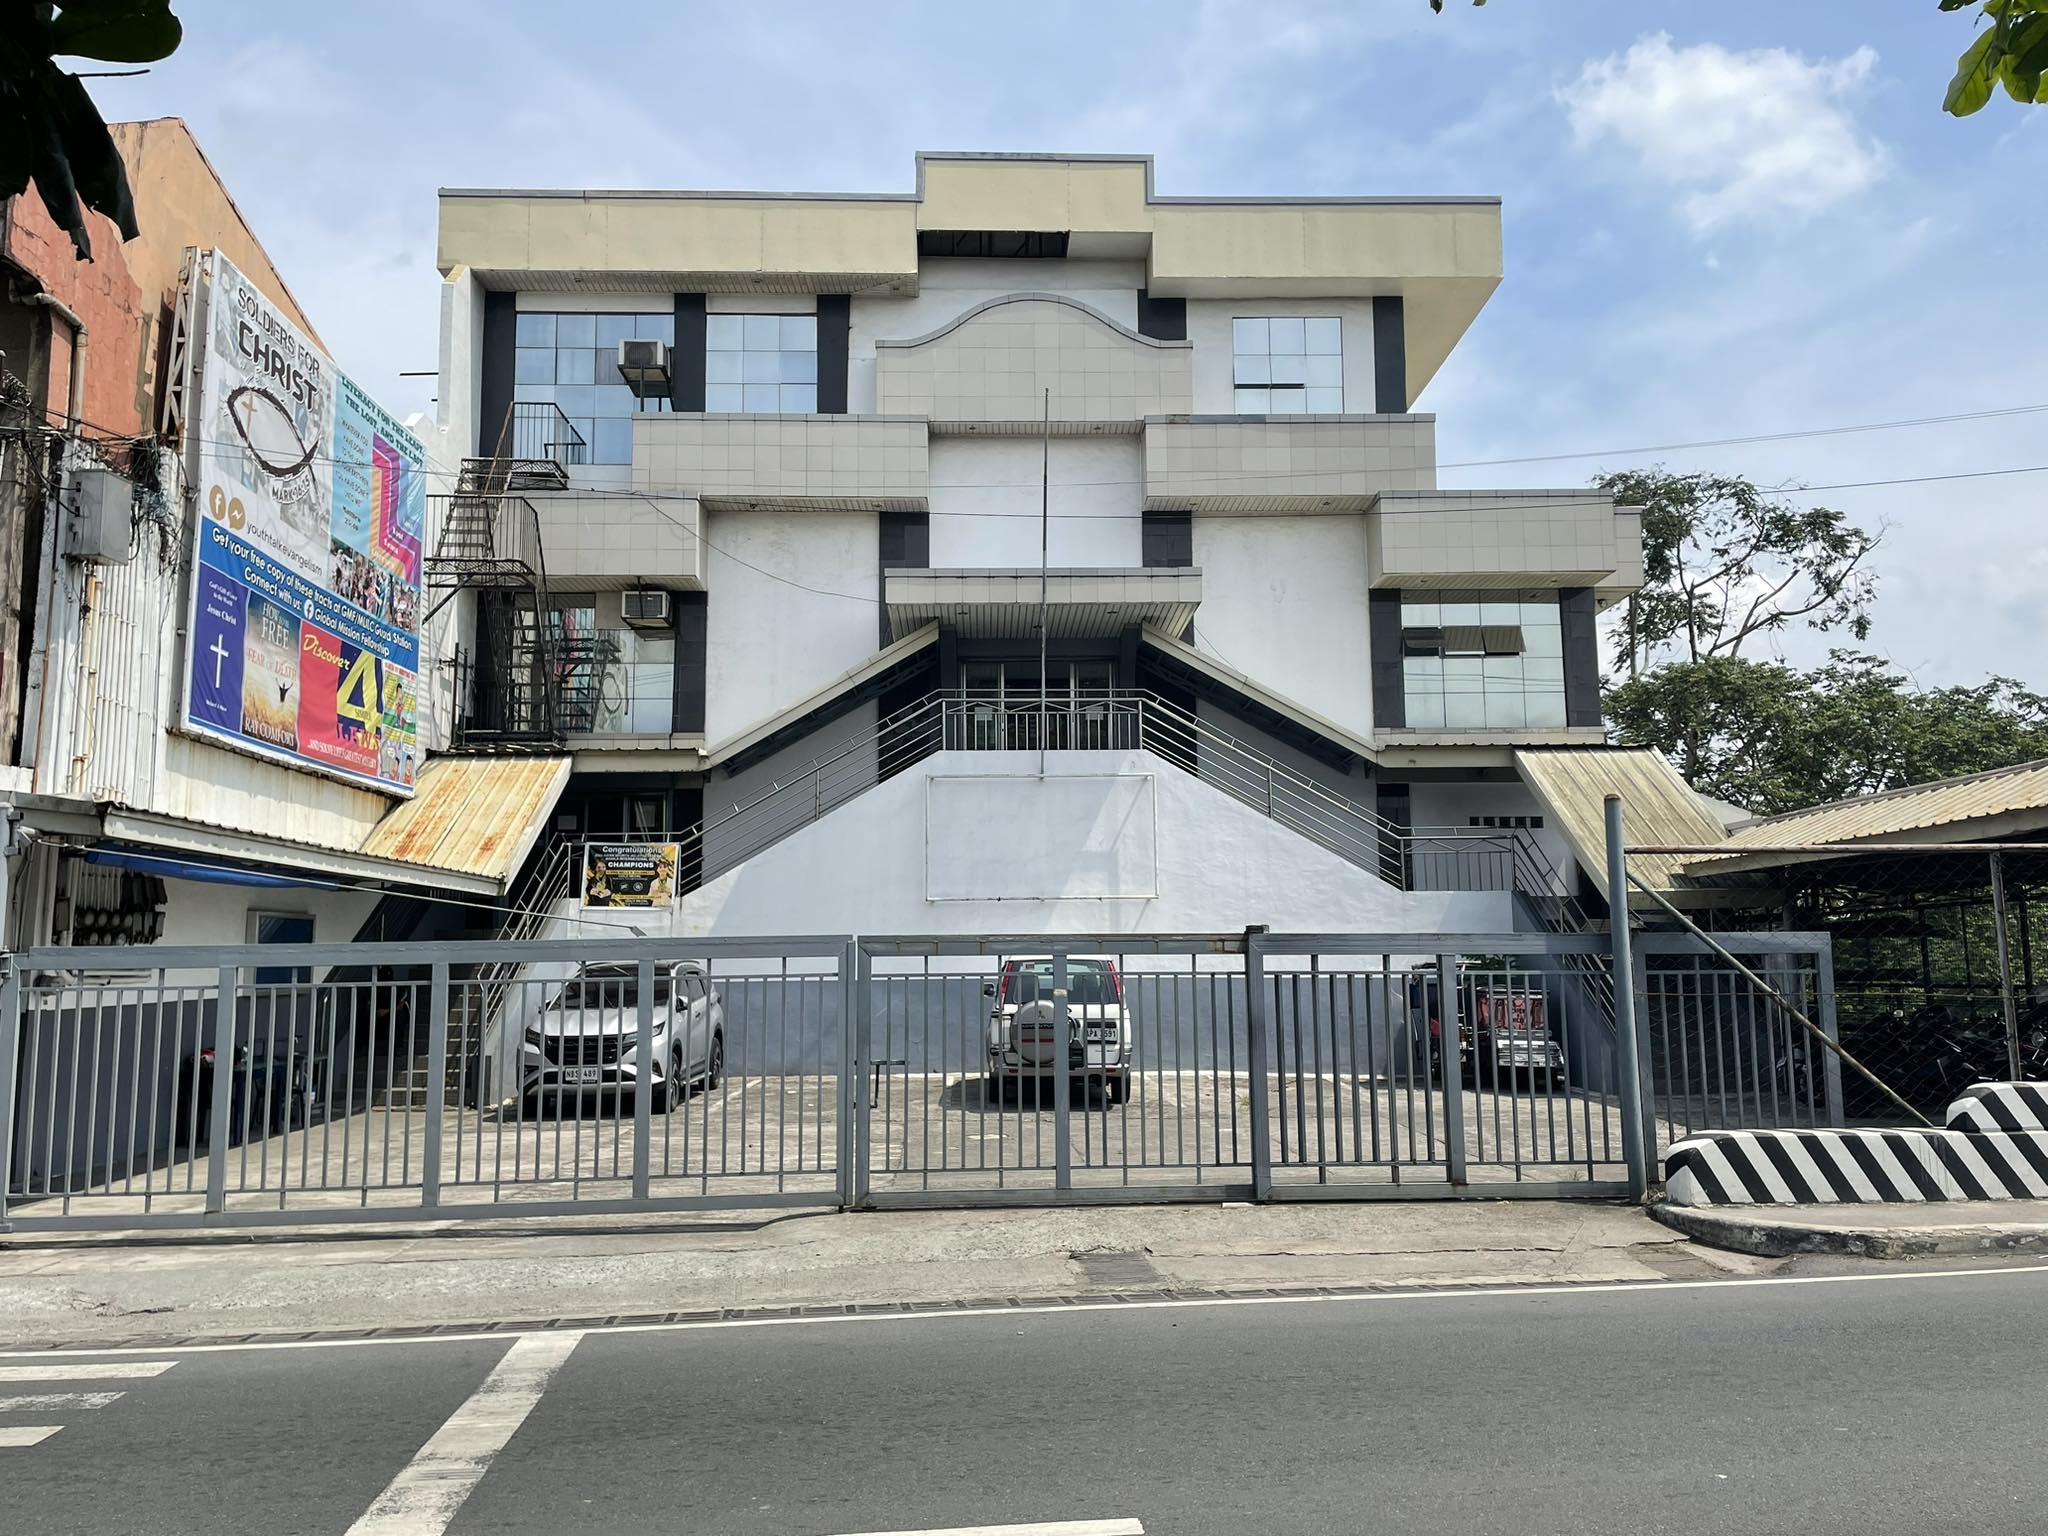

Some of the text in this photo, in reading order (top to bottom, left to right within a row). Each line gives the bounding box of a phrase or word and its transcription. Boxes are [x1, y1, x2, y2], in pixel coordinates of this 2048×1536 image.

[238, 287, 319, 375] SOLDIERS FOR
[238, 319, 317, 410] CHRIST
[341, 376, 423, 456] LITERACY FOR THE LEAST,
[345, 394, 422, 467] THE LOST, AND THE LAST
[212, 528, 228, 547] Get
[229, 540, 248, 562] your
[250, 551, 265, 568] free
[267, 563, 284, 583] copy
[287, 574, 294, 586] of
[295, 578, 312, 598] these
[314, 590, 332, 609] tracts
[333, 600, 340, 614] at
[247, 522, 322, 577] youthtalkevangelism
[244, 566, 276, 594] Connect
[278, 586, 292, 603] with
[207, 604, 236, 624] Jesus Christ
[261, 618, 289, 650] FREE
[262, 603, 278, 621] HOW
[314, 608, 336, 629] Global
[338, 621, 359, 641] Mission
[361, 632, 389, 657] Fellowship
[248, 647, 265, 666] FEAR
[274, 659, 296, 680] DEATH
[303, 635, 350, 670] Discover
[336, 650, 383, 734] 4
[245, 717, 293, 747] RAY COMFORT
